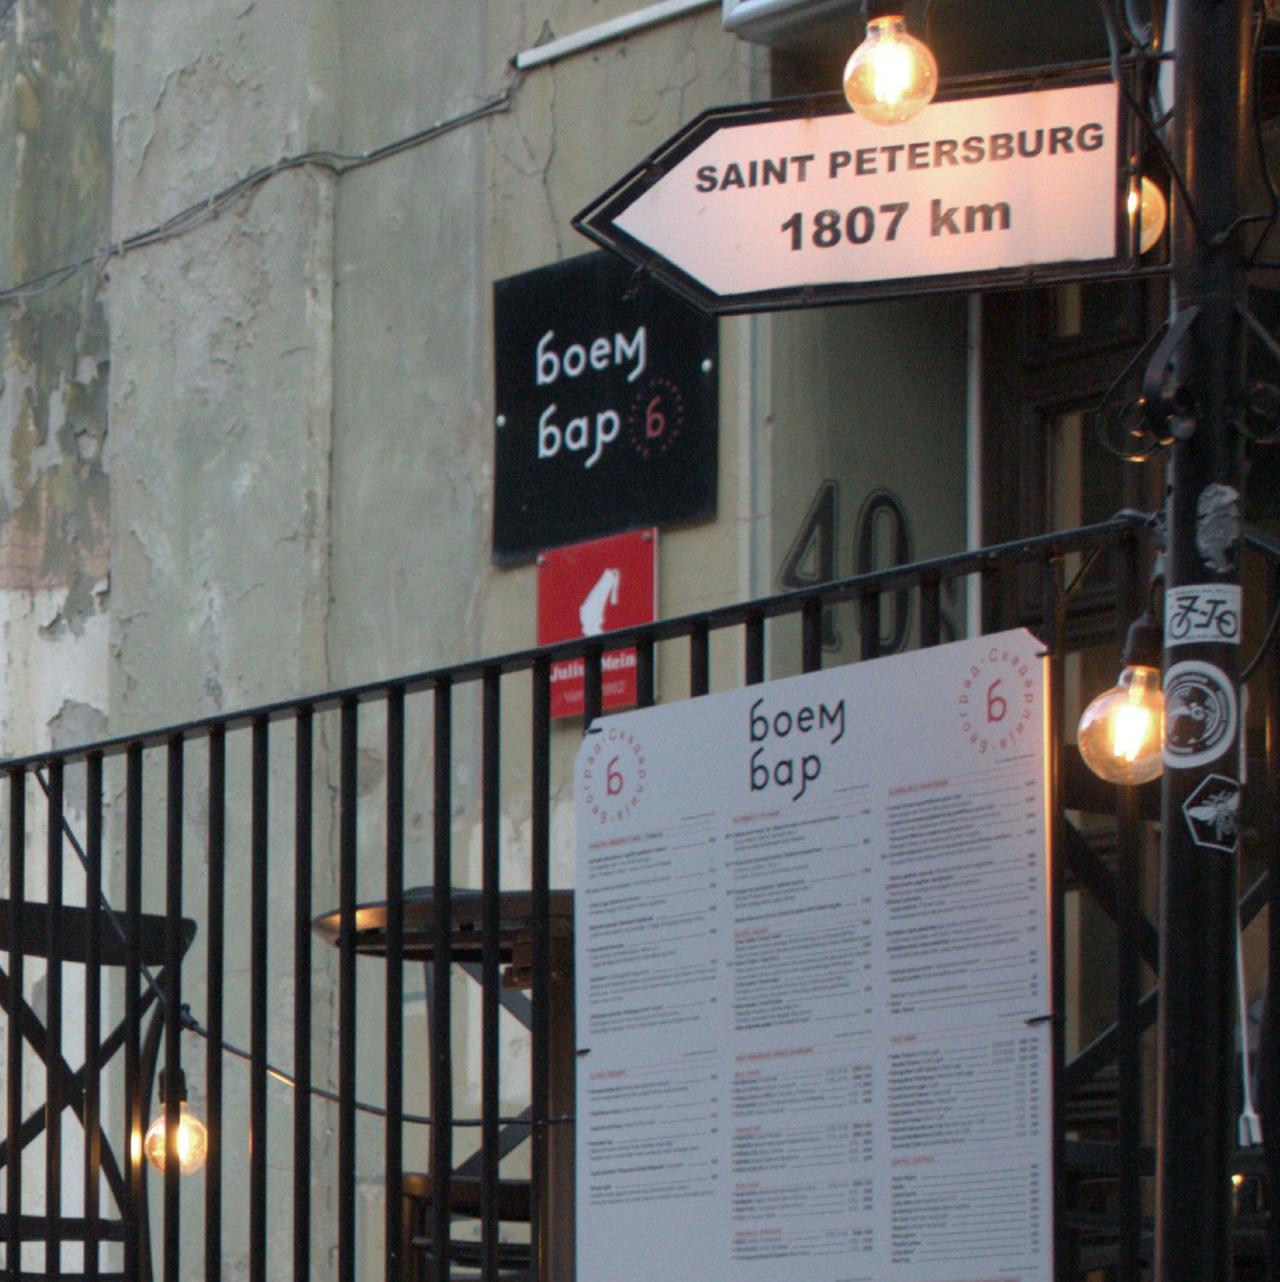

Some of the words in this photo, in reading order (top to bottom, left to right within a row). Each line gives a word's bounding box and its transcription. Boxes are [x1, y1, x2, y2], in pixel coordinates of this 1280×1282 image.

[695, 154, 815, 194] SAINT
[827, 122, 1106, 179] PETERSBURG
[780, 200, 910, 252] 1807
[929, 198, 1012, 237] km
[549, 660, 585, 683] Juli
[600, 652, 637, 671] Mein
